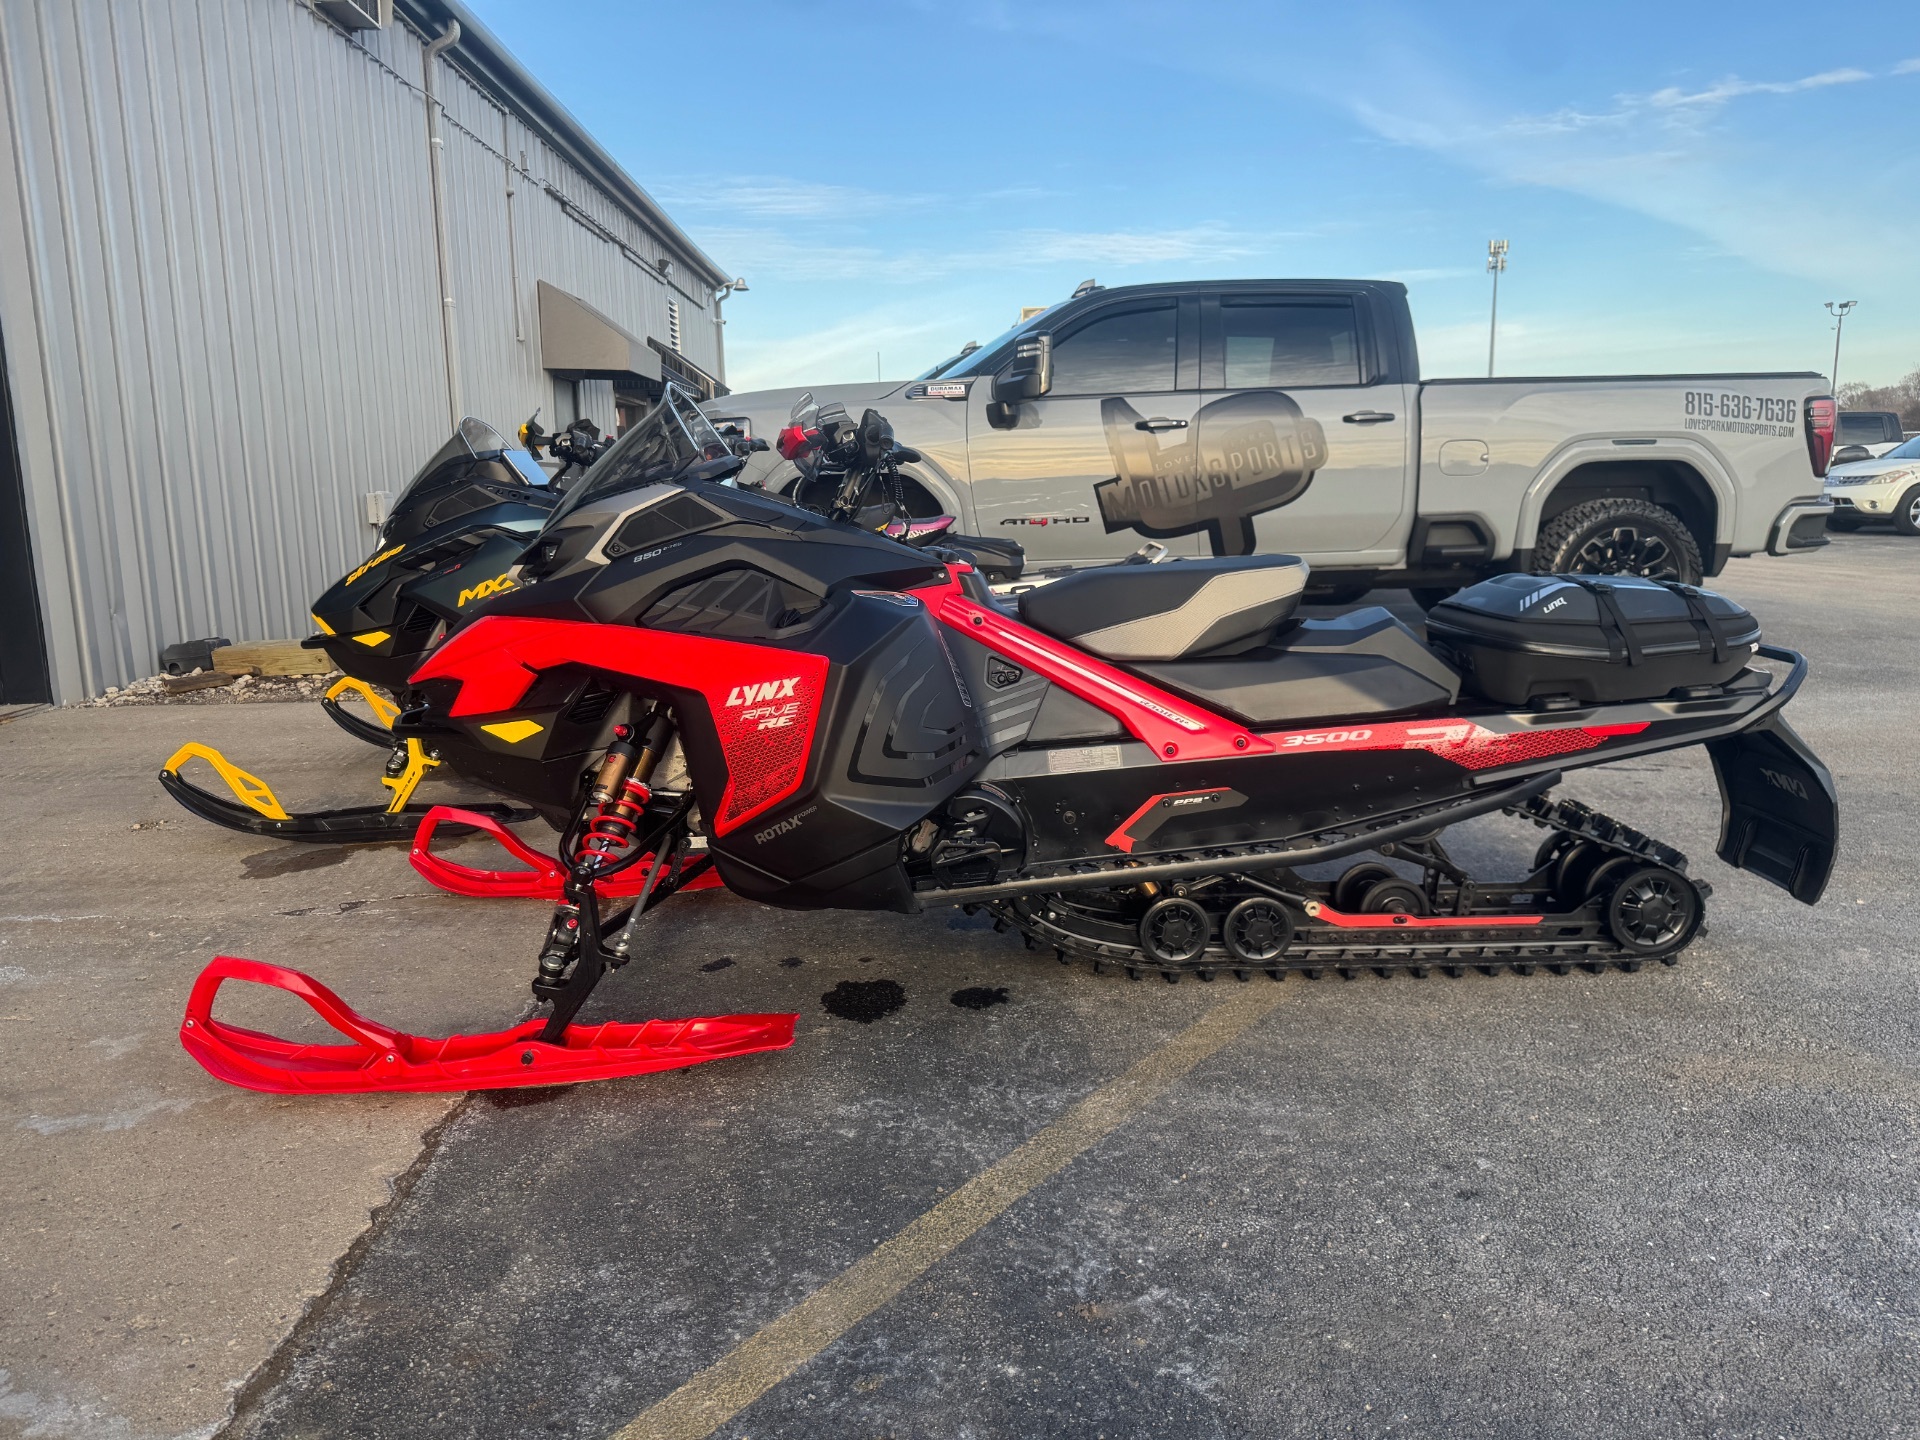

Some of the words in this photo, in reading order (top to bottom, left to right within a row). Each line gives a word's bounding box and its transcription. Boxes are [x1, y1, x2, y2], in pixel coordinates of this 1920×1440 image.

[1685, 391, 1797, 423] 815-636-7636
[1684, 418, 1795, 438] LOVESPARKMOTORSPORTS.COM
[1106, 430, 1317, 520] MOTORSPORTS
[1000, 517, 1048, 527] AT4
[1053, 516, 1090, 524] HD
[633, 548, 662, 563] 850
[725, 676, 801, 707] LYNX
[740, 701, 801, 722] RAVE
[757, 714, 796, 731] RE
[1281, 729, 1373, 748] 3500
[754, 814, 803, 845] ROTAX
